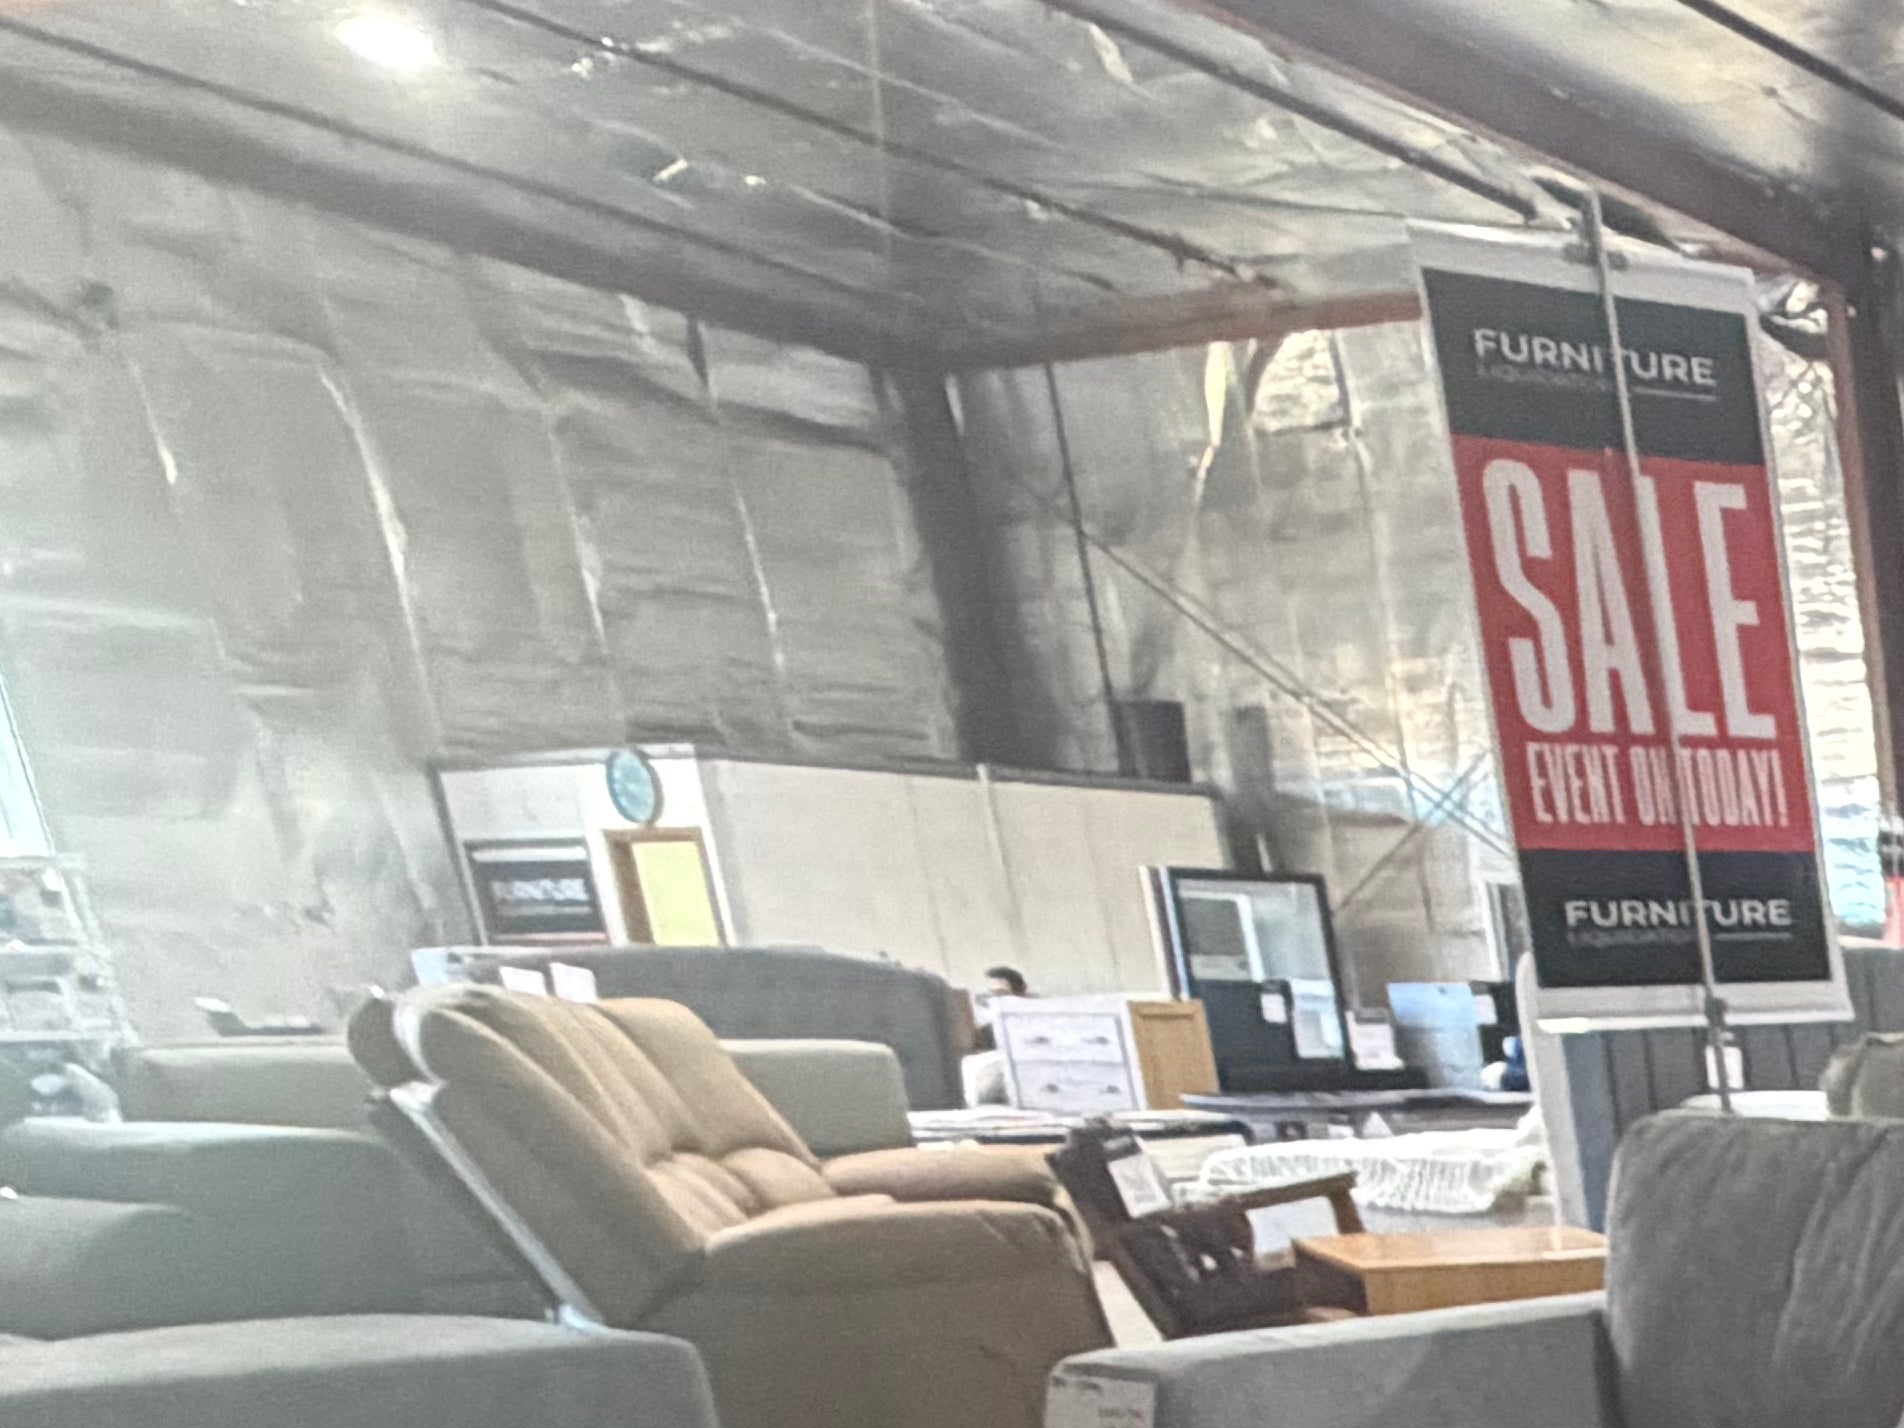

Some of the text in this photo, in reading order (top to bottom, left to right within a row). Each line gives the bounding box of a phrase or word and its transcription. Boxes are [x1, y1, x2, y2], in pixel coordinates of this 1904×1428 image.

[1472, 327, 1717, 387] FURNIURE
[1482, 458, 1777, 740] SALE
[1526, 742, 1790, 827] EVENT ON TODAY!
[1564, 899, 1792, 928] FURNIURE
